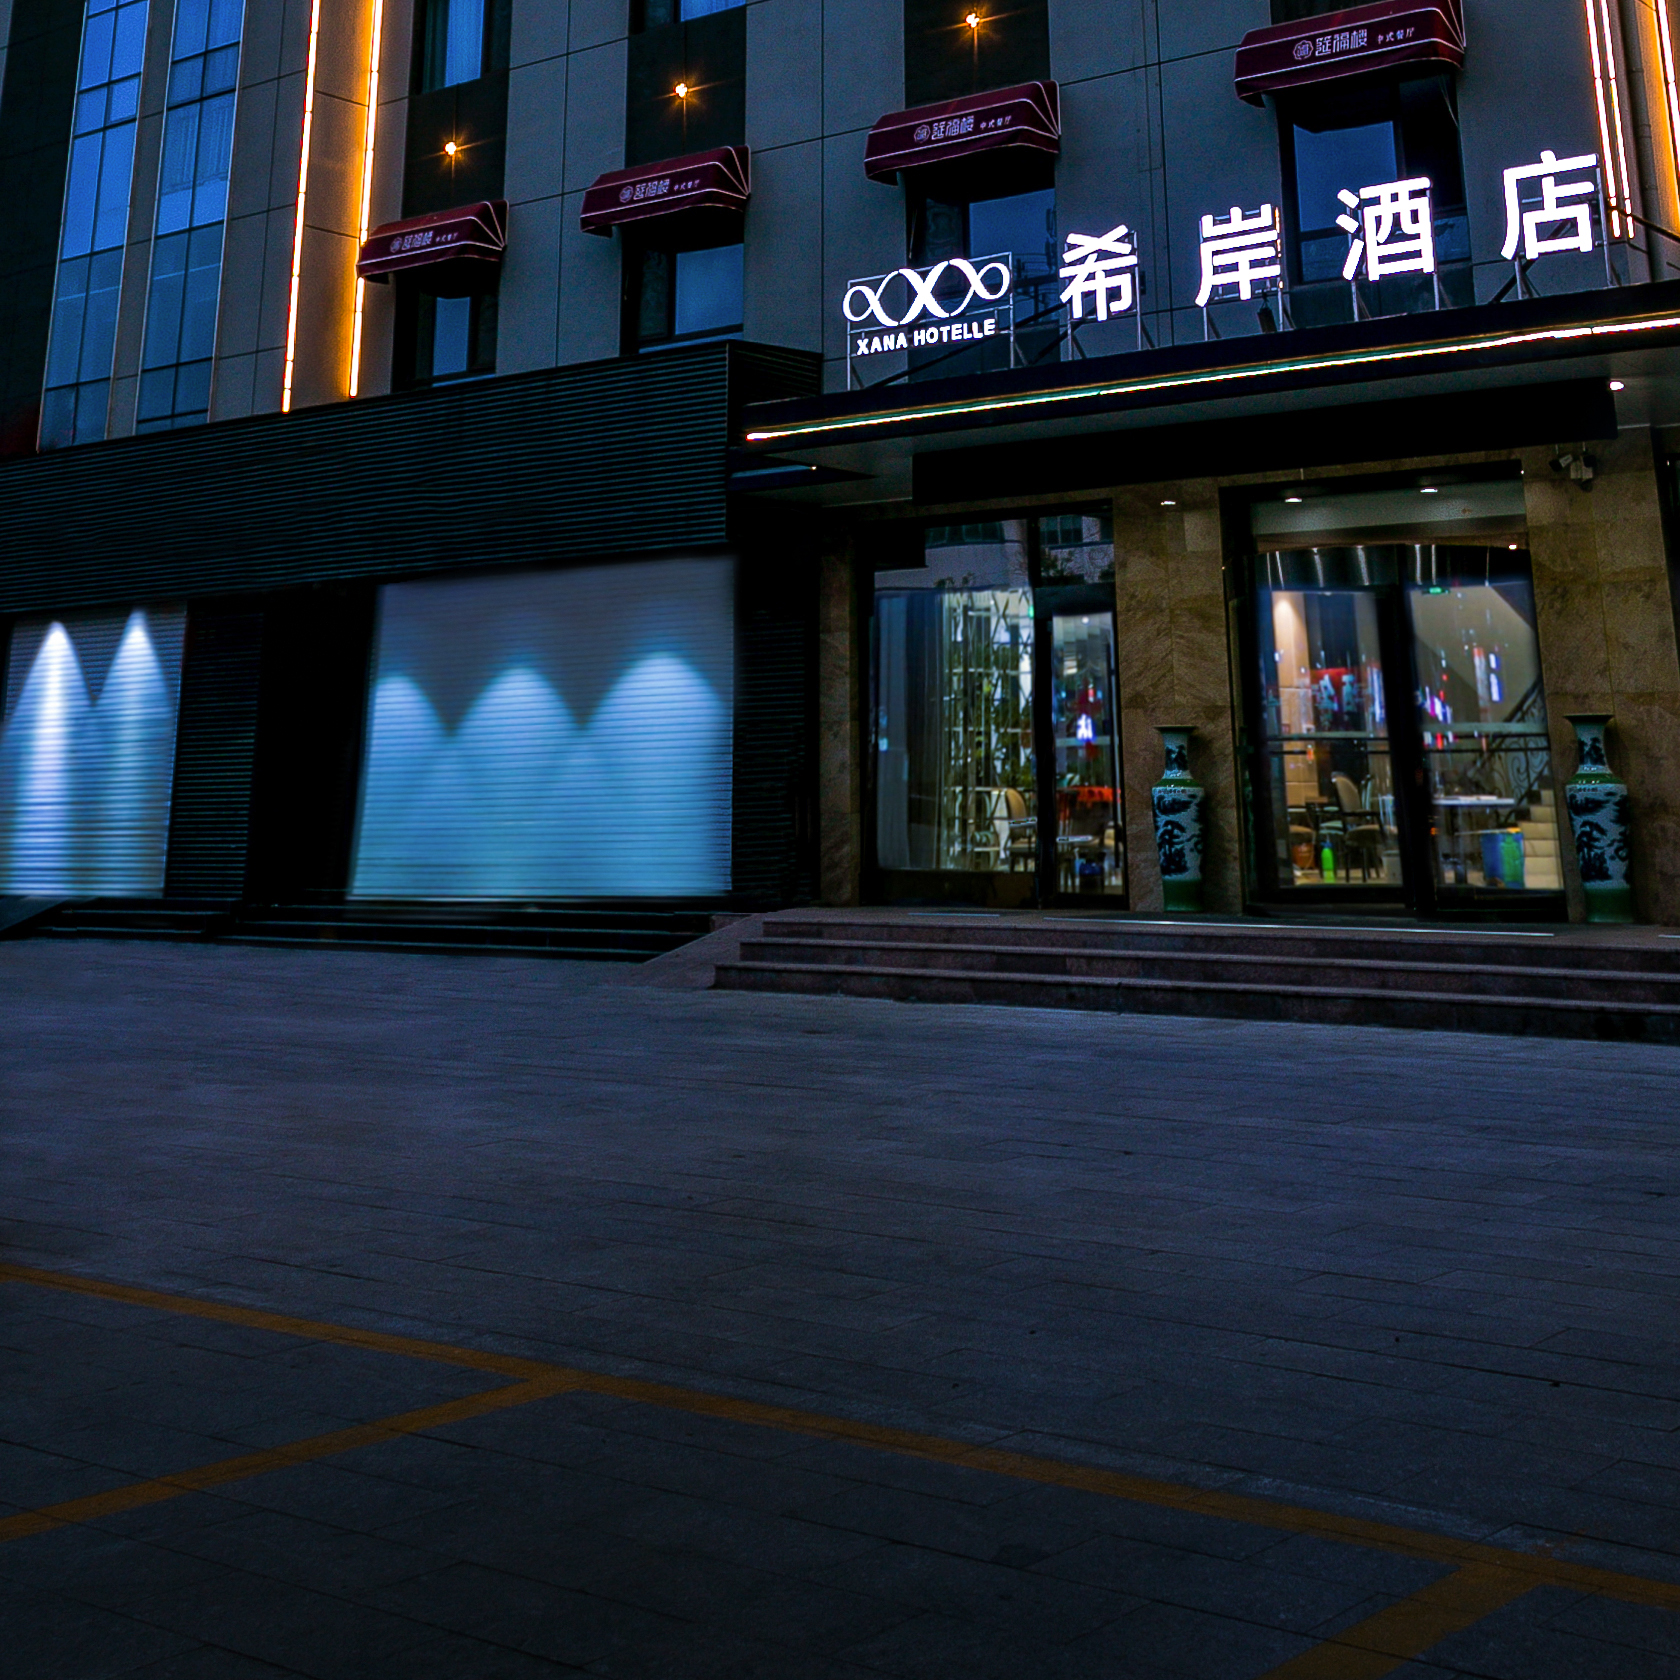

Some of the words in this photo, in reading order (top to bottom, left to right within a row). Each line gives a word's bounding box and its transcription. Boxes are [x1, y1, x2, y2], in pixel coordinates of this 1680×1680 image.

[1059, 150, 1598, 322] 希岸酒店
[856, 332, 908, 356] XANA
[913, 319, 997, 347] HOTELLE
